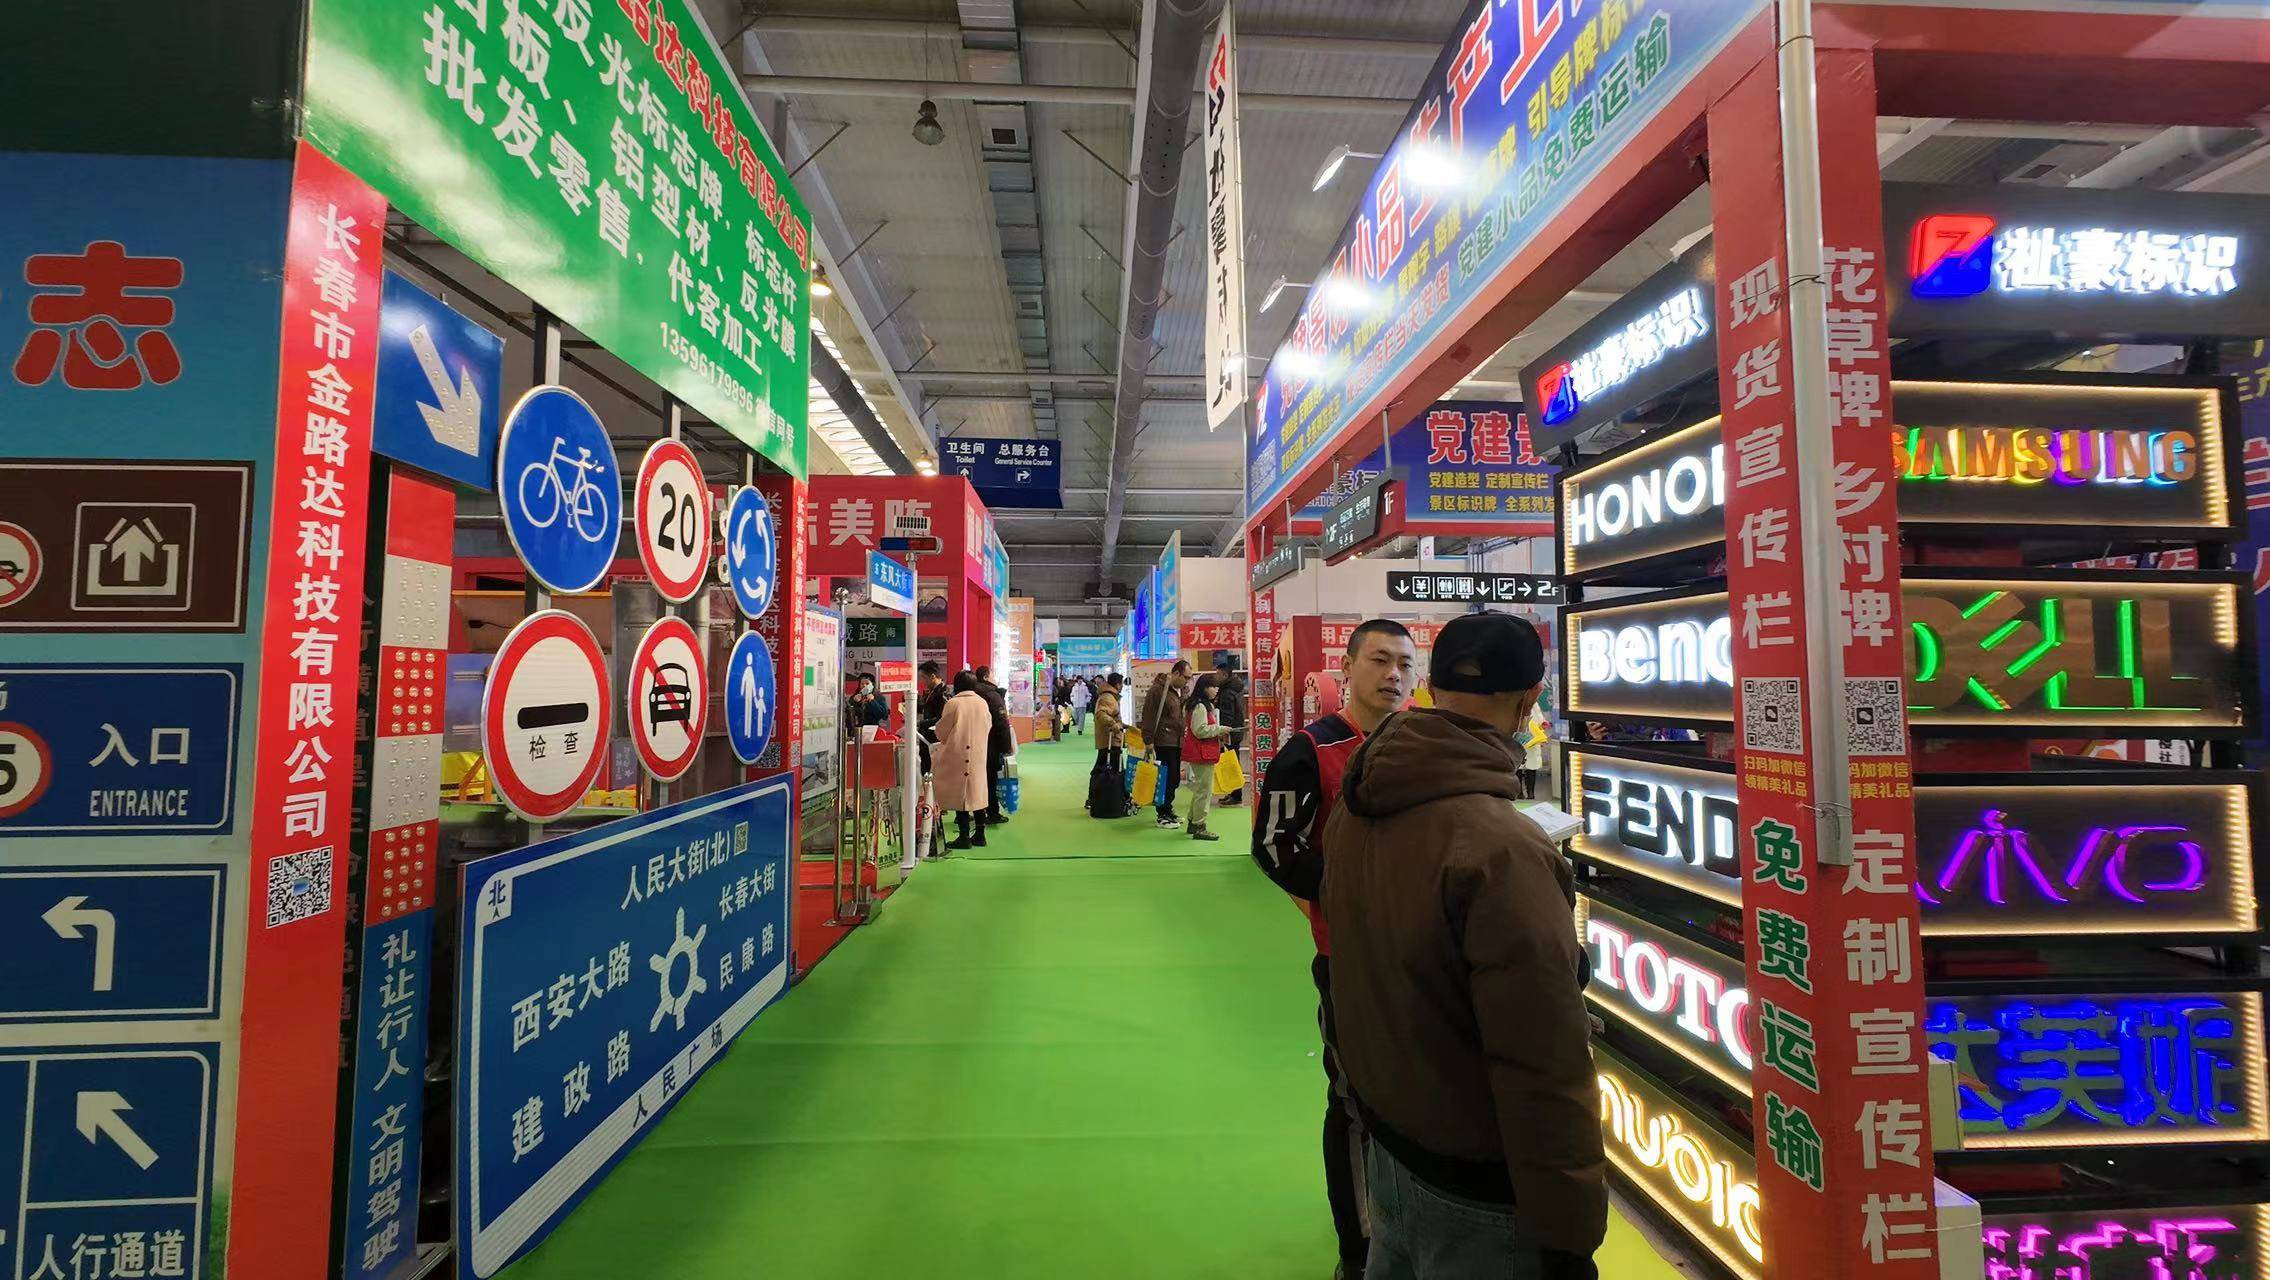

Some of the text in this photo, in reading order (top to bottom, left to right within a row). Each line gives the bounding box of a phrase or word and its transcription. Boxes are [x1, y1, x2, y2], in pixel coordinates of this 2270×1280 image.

[1457, 9, 1671, 289] 党建小品免费运输
[13, 240, 184, 390] 志
[1821, 246, 1883, 429] 花草牌
[946, 442, 1050, 457] 卫生间 总服务台
[955, 456, 975, 464] Toilet
[1428, 471, 1549, 490] 党建造型 定制宣传栏
[1729, 256, 1795, 651] 现货宣传栏
[281, 202, 361, 839] 长春市金路达科技有限公司
[657, 482, 696, 558] 20
[1537, 580, 1559, 597] 2F
[89, 723, 191, 767] 入口
[529, 730, 580, 760] 检查
[89, 787, 189, 818] ENTRANCE
[488, 879, 506, 908] 北
[719, 862, 776, 923] 长春大街
[510, 941, 632, 1054] 西安大路
[719, 922, 775, 993] 民康路
[1587, 919, 1753, 1071] TOTO
[1753, 816, 1826, 1194] 免费运输
[1841, 828, 1933, 1266] 定制宣传栏
[361, 929, 417, 1273] 礼让行人 文明驾驶
[511, 1029, 632, 1164] 建政路
[632, 1023, 724, 1129] 人民广场
[29, 1229, 186, 1280] 人行通道
